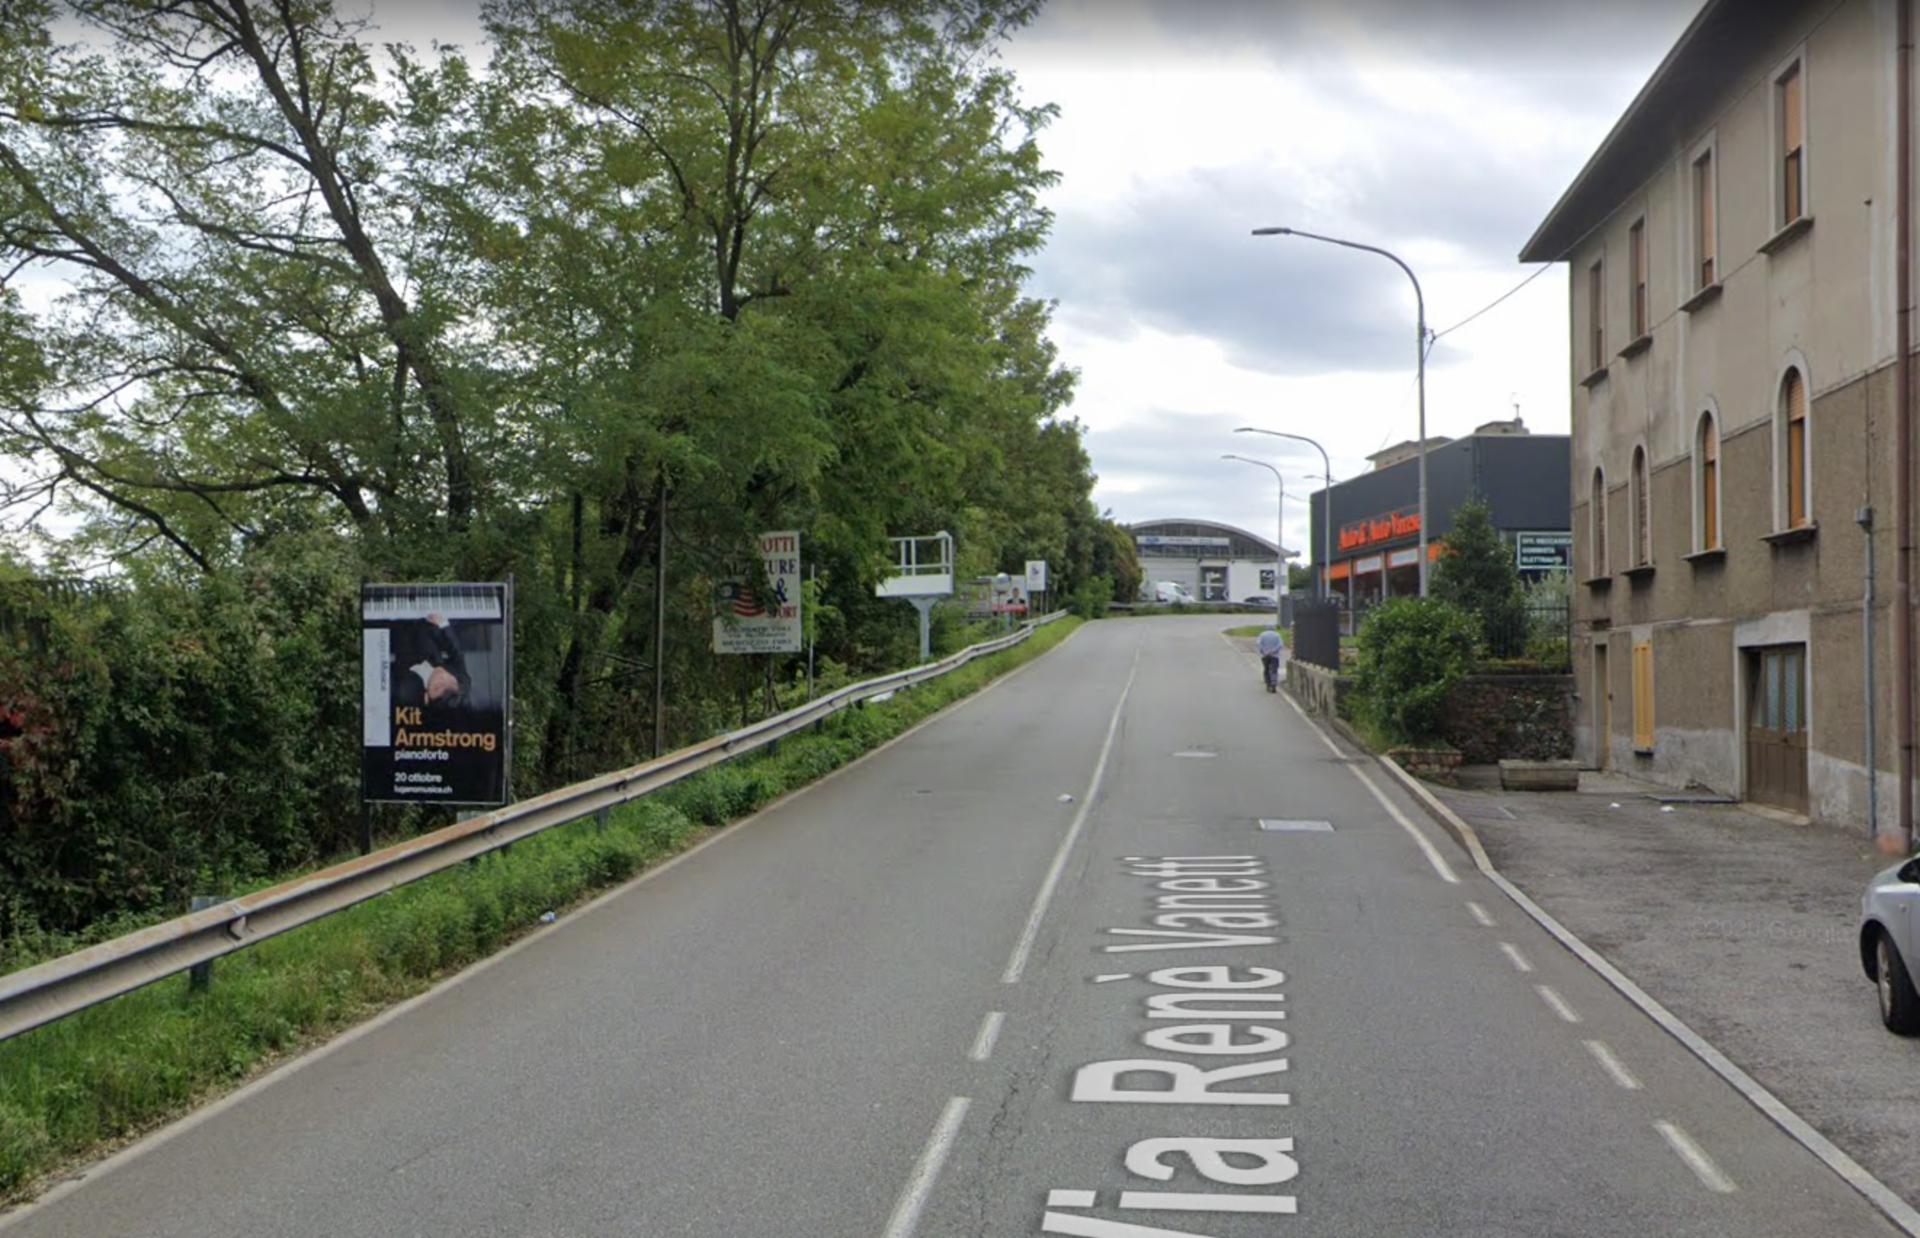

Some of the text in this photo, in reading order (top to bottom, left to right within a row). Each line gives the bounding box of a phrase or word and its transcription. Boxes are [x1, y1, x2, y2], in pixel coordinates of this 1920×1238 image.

[395, 706, 422, 726] Kit
[395, 729, 496, 751] Armstrong
[394, 749, 449, 761] pianoforte
[394, 772, 443, 784] 20 ottobre
